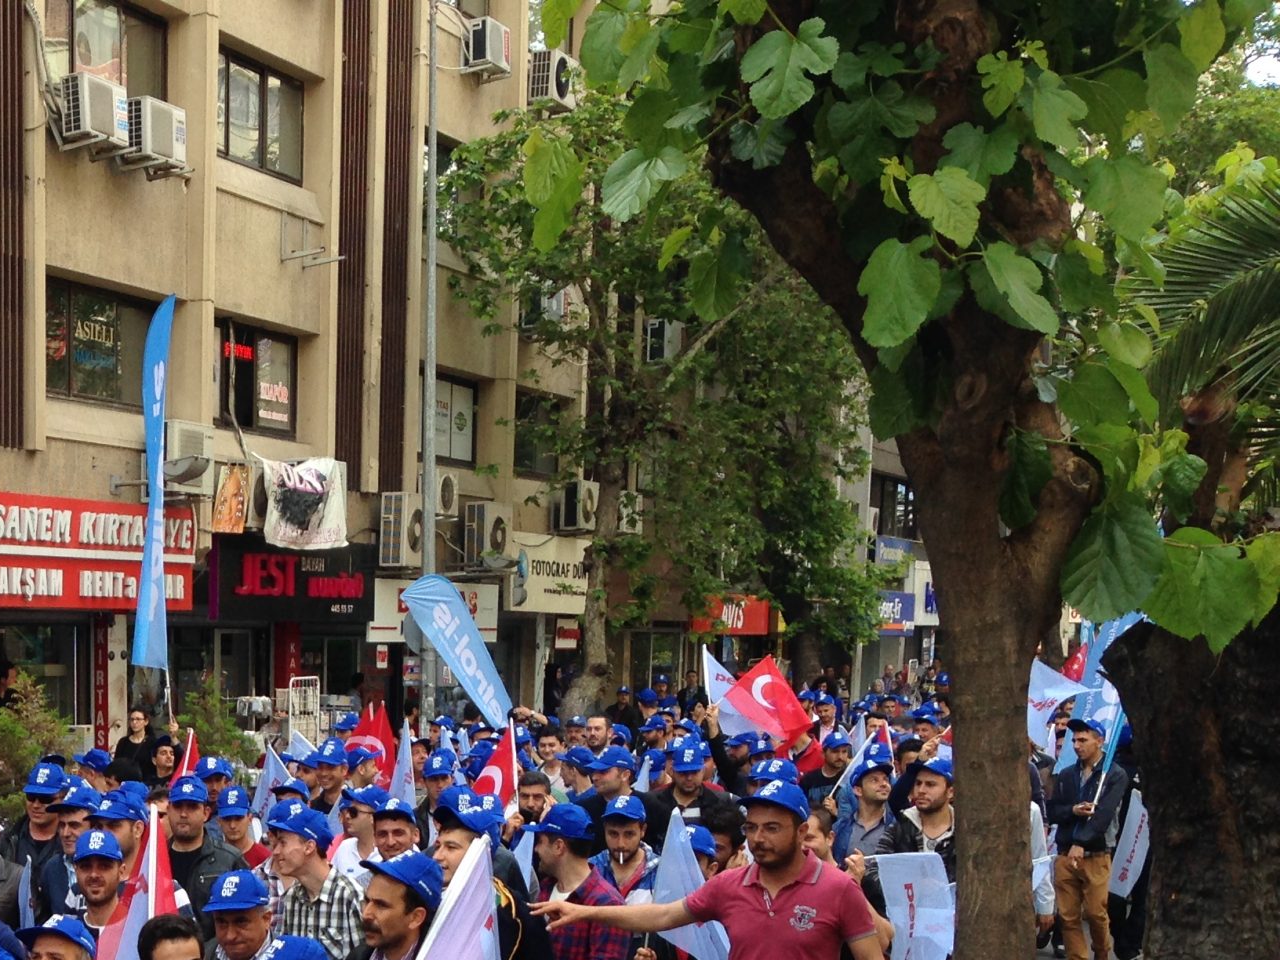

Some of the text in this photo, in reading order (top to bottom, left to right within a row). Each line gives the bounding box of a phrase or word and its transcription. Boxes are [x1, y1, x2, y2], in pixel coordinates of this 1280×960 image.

[165, 574, 184, 600] AR
[233, 553, 299, 597] JEST
[96, 628, 104, 747] KIRTAS
